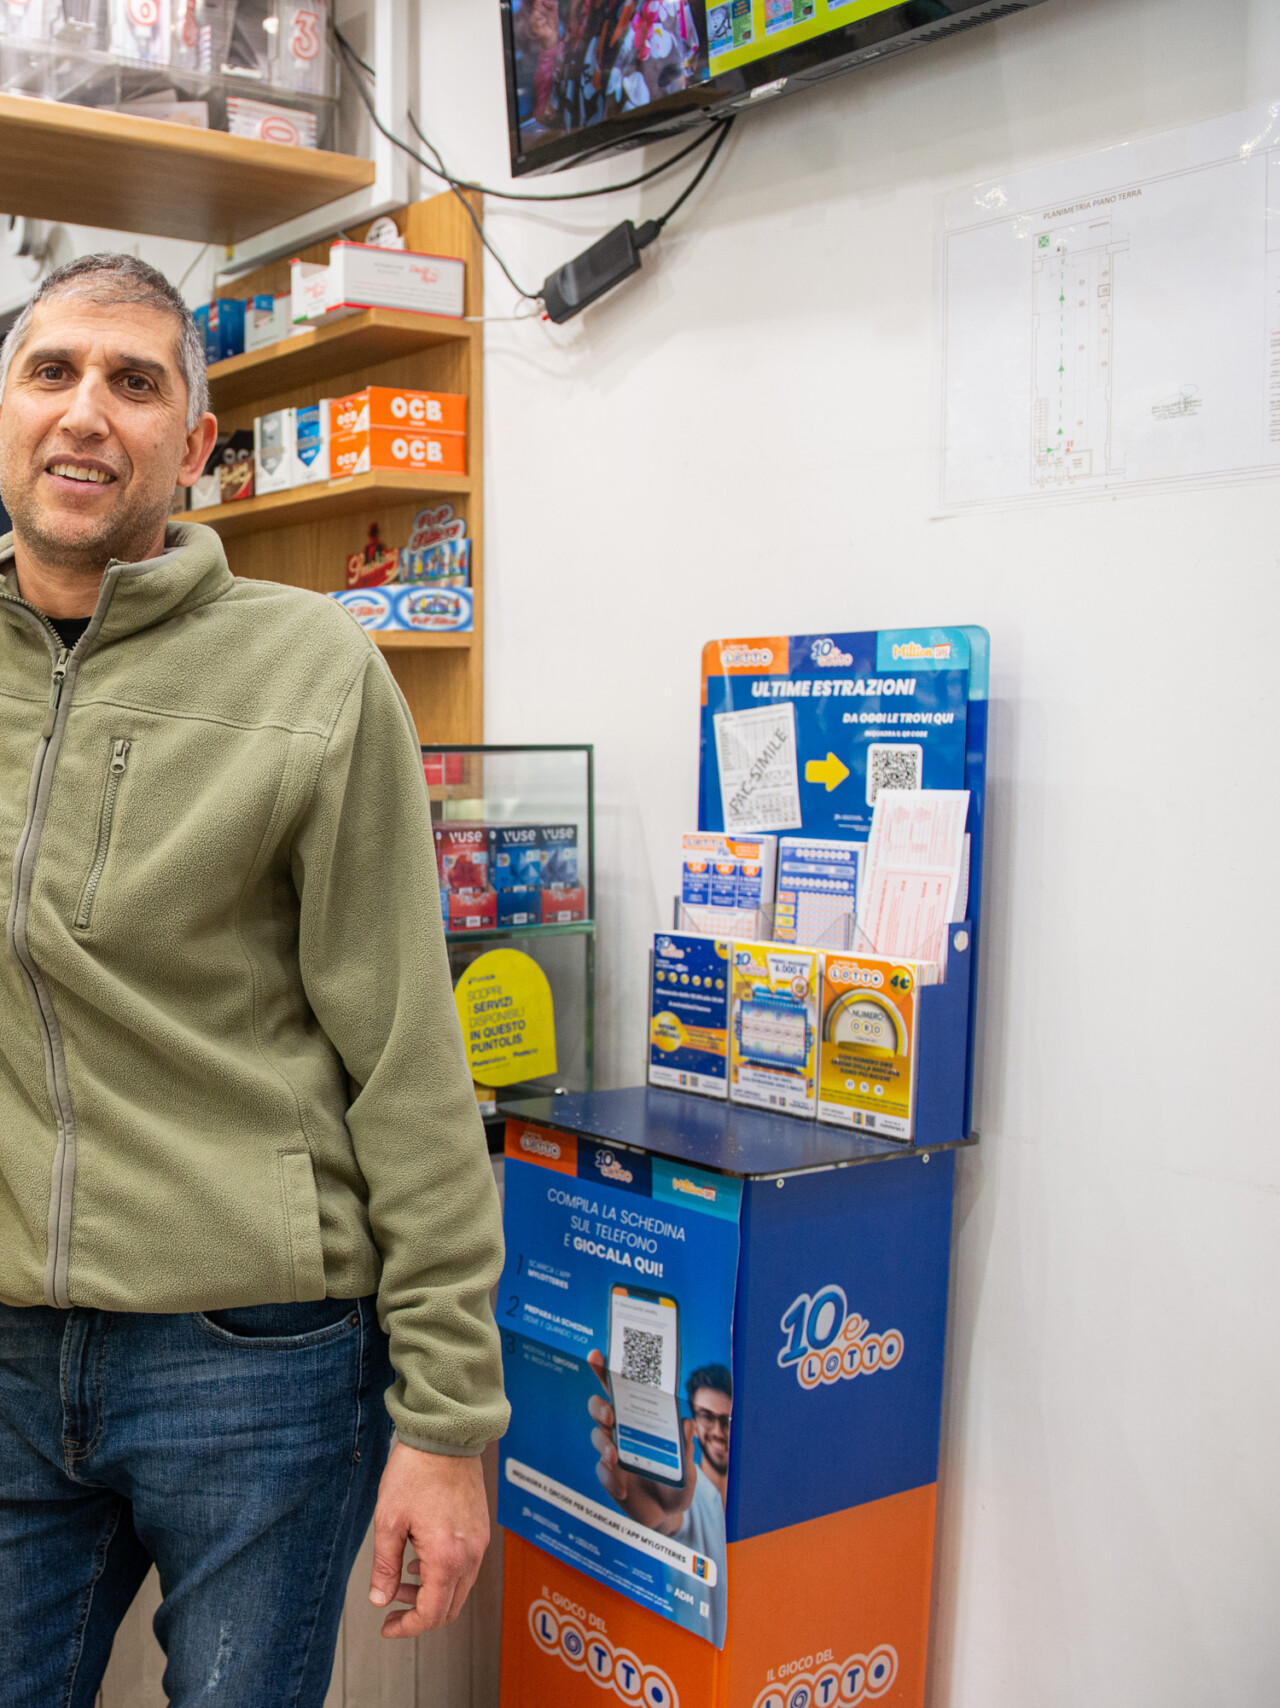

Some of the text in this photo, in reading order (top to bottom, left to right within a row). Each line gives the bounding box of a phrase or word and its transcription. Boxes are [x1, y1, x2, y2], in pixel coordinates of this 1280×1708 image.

[1043, 188, 1142, 219] PLANIMETRIA PIANO TERRA
[337, 411, 357, 426] OCB
[391, 397, 442, 421] OCB
[391, 437, 443, 462] OCB
[811, 639, 834, 661] 10
[892, 642, 933, 660] Million
[751, 678, 917, 698] ULTIME ESTRAZIONI
[842, 713, 954, 724] DA OGGI LE TROVI QUI
[729, 727, 789, 813] FAC-SIMILE
[828, 964, 884, 988] LOTTO
[890, 975, 910, 989] 4€
[474, 996, 512, 1014] SERVIZI
[852, 1009, 884, 1021] NUMERO
[470, 1019, 526, 1040] IN QUESTO
[851, 1019, 884, 1037] ORO
[471, 1033, 523, 1054] PUNTOLIS
[547, 1188, 686, 1242] COMPILA LA SCHEDINA
[570, 1215, 658, 1254] SUL TELEFONO
[564, 1233, 664, 1278] E GIOCALA QUI!
[778, 1285, 904, 1390] 10 LOTTO
[573, 1501, 585, 1512] PER
[585, 1507, 621, 1531] SCARICARE
[640, 1536, 687, 1564] MYLOTTERIES
[674, 1588, 695, 1606] ADM
[542, 1585, 608, 1634] IL GIOCO DEL
[528, 1600, 679, 1708] LOTTO
[767, 1649, 835, 1682] IL GIOCO DEL
